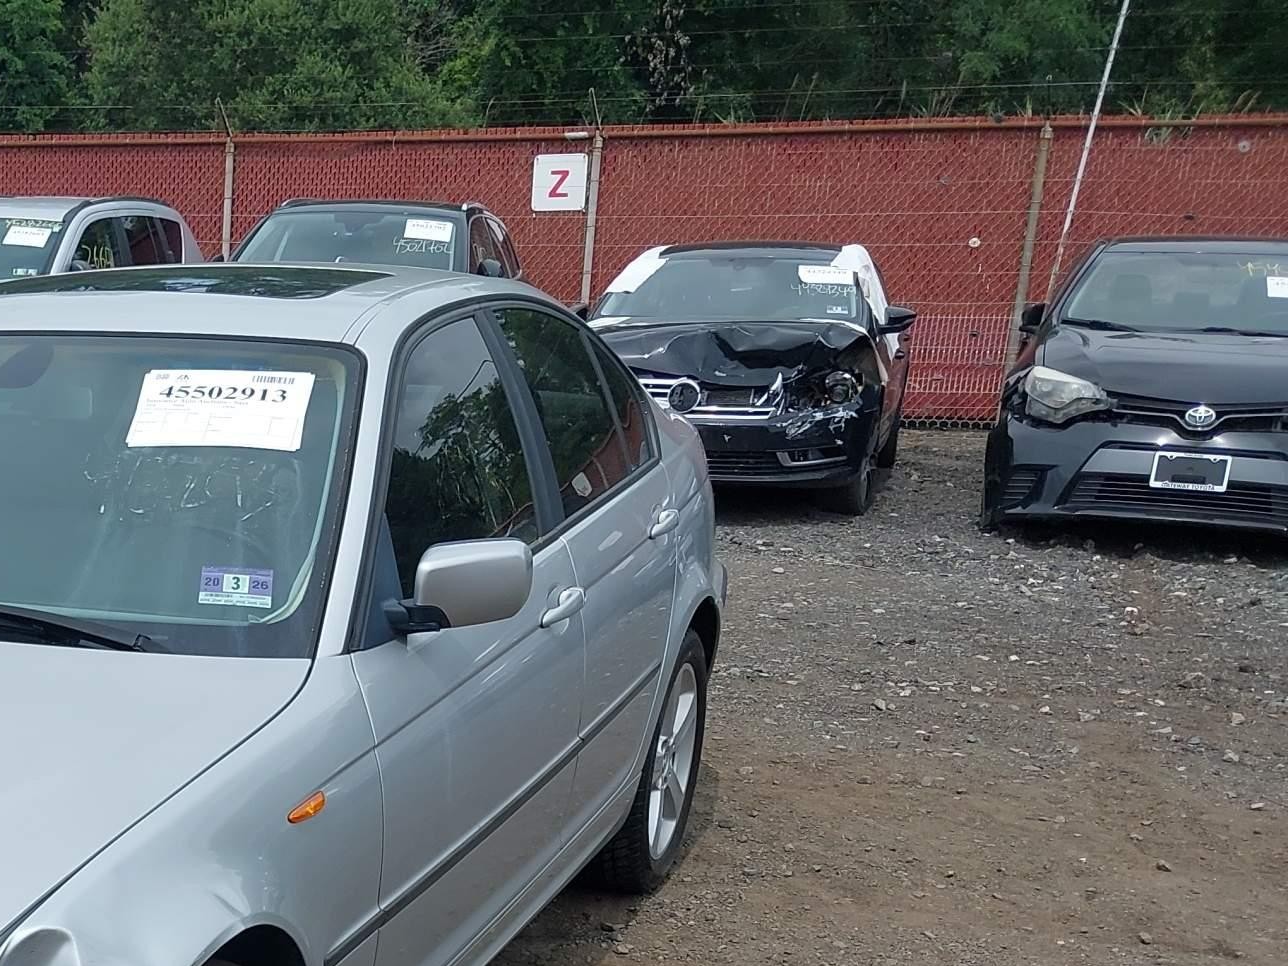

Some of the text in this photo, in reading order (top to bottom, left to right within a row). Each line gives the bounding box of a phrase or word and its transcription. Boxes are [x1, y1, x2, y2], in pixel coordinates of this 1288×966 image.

[548, 170, 569, 198] Z
[159, 385, 288, 403] 45502913
[204, 576, 269, 591] 20 3 26
